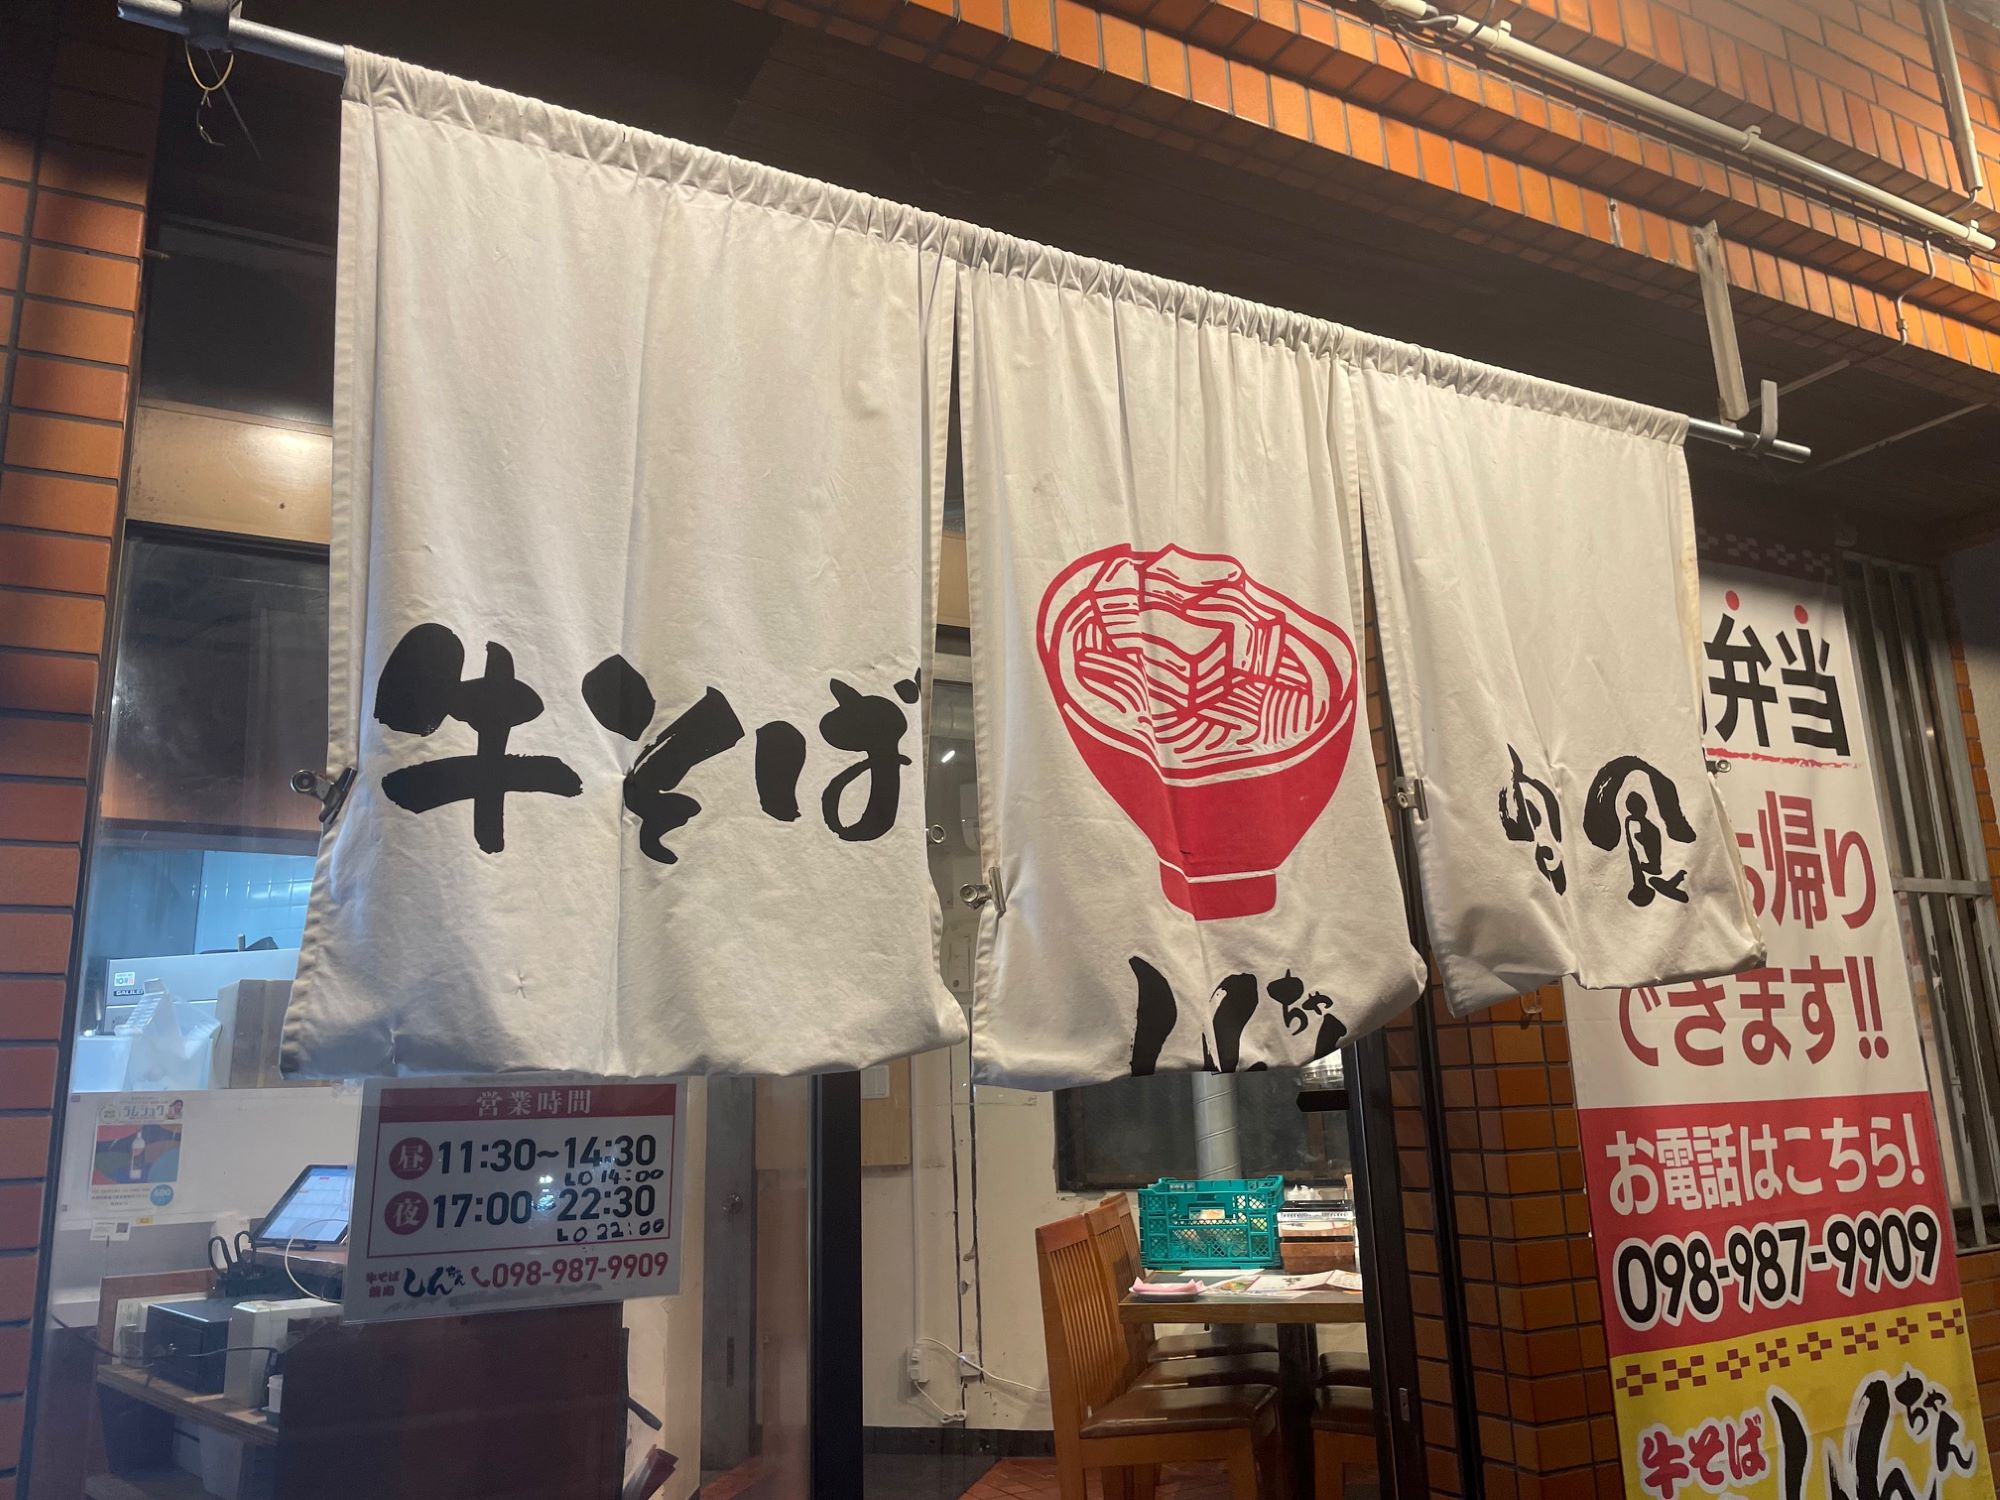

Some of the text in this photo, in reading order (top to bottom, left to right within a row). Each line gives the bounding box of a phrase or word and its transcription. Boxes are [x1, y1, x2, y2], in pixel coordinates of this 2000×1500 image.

[1702, 613, 1851, 757] 弁当
[373, 622, 920, 864] 牛そば
[475, 1089, 591, 1117] 営業時間
[397, 1144, 425, 1172] 昼
[1605, 1112, 1926, 1216] お電話はこちら!
[564, 1168, 664, 1186] LO 14:00
[392, 1198, 421, 1228] 夜
[557, 1218, 665, 1242] LO 22:00
[490, 1252, 669, 1289] 098-987-9909
[1616, 1208, 1940, 1327] 098-987-9909
[1641, 1413, 1767, 1500] 牛そば
